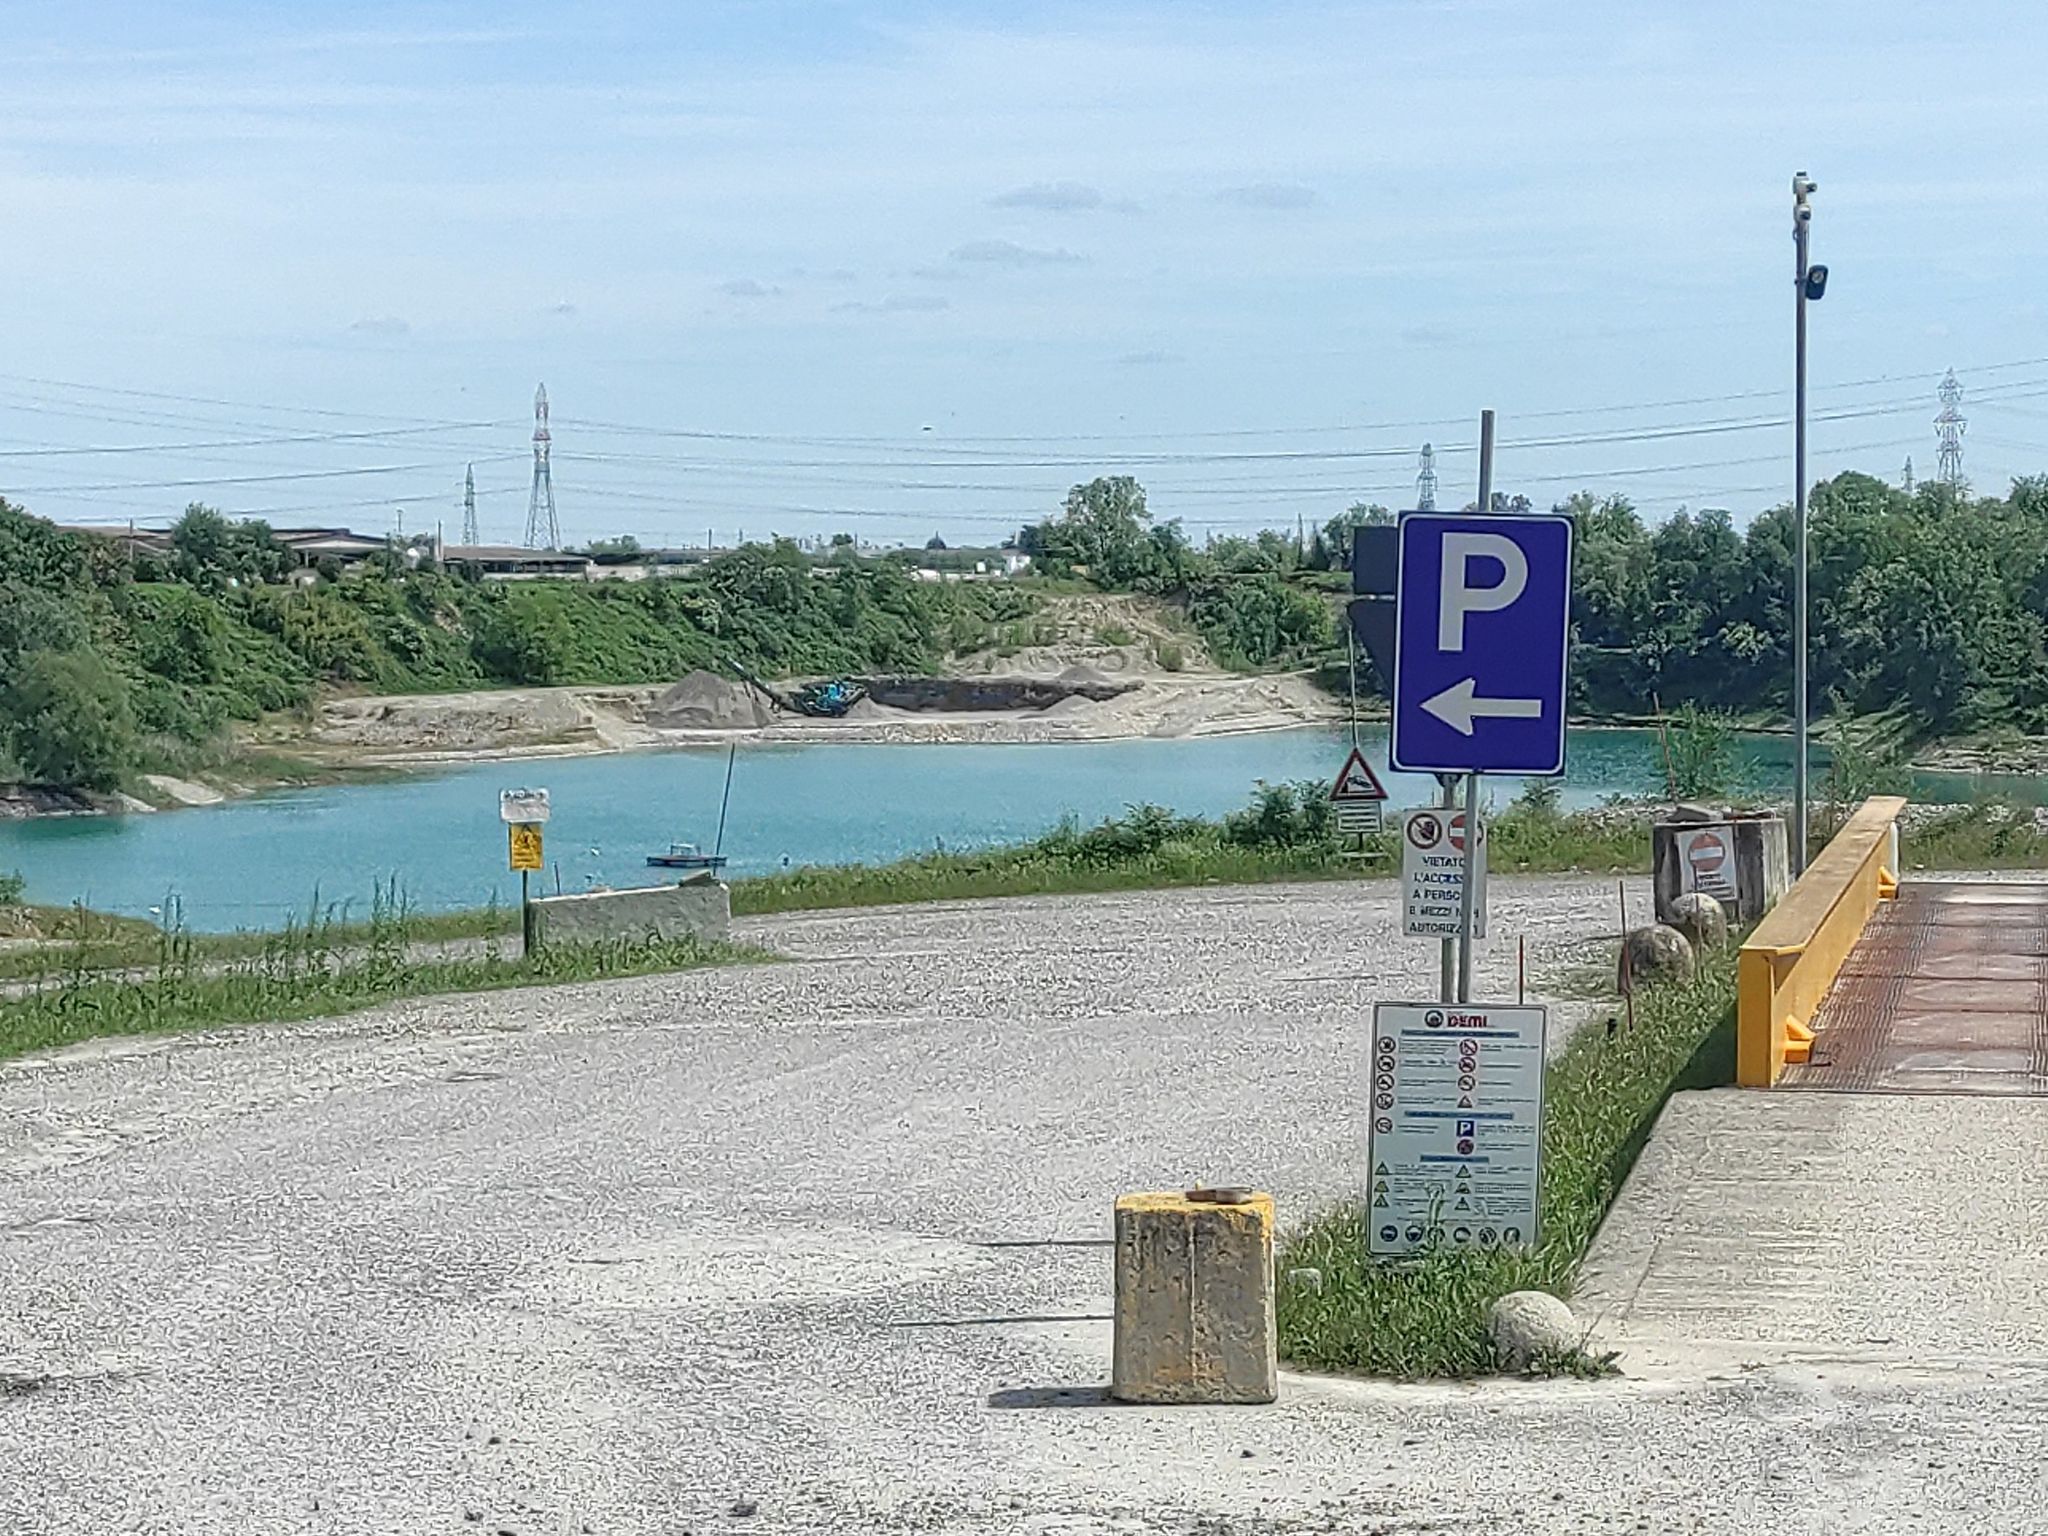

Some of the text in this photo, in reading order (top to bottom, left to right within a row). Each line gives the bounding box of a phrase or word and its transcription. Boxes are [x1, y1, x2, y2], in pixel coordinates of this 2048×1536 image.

[1438, 532, 1528, 651] P
[1413, 889, 1461, 900] A PERSO
[1447, 1015, 1488, 1028] DEMI
[1460, 1122, 1472, 1135] P
